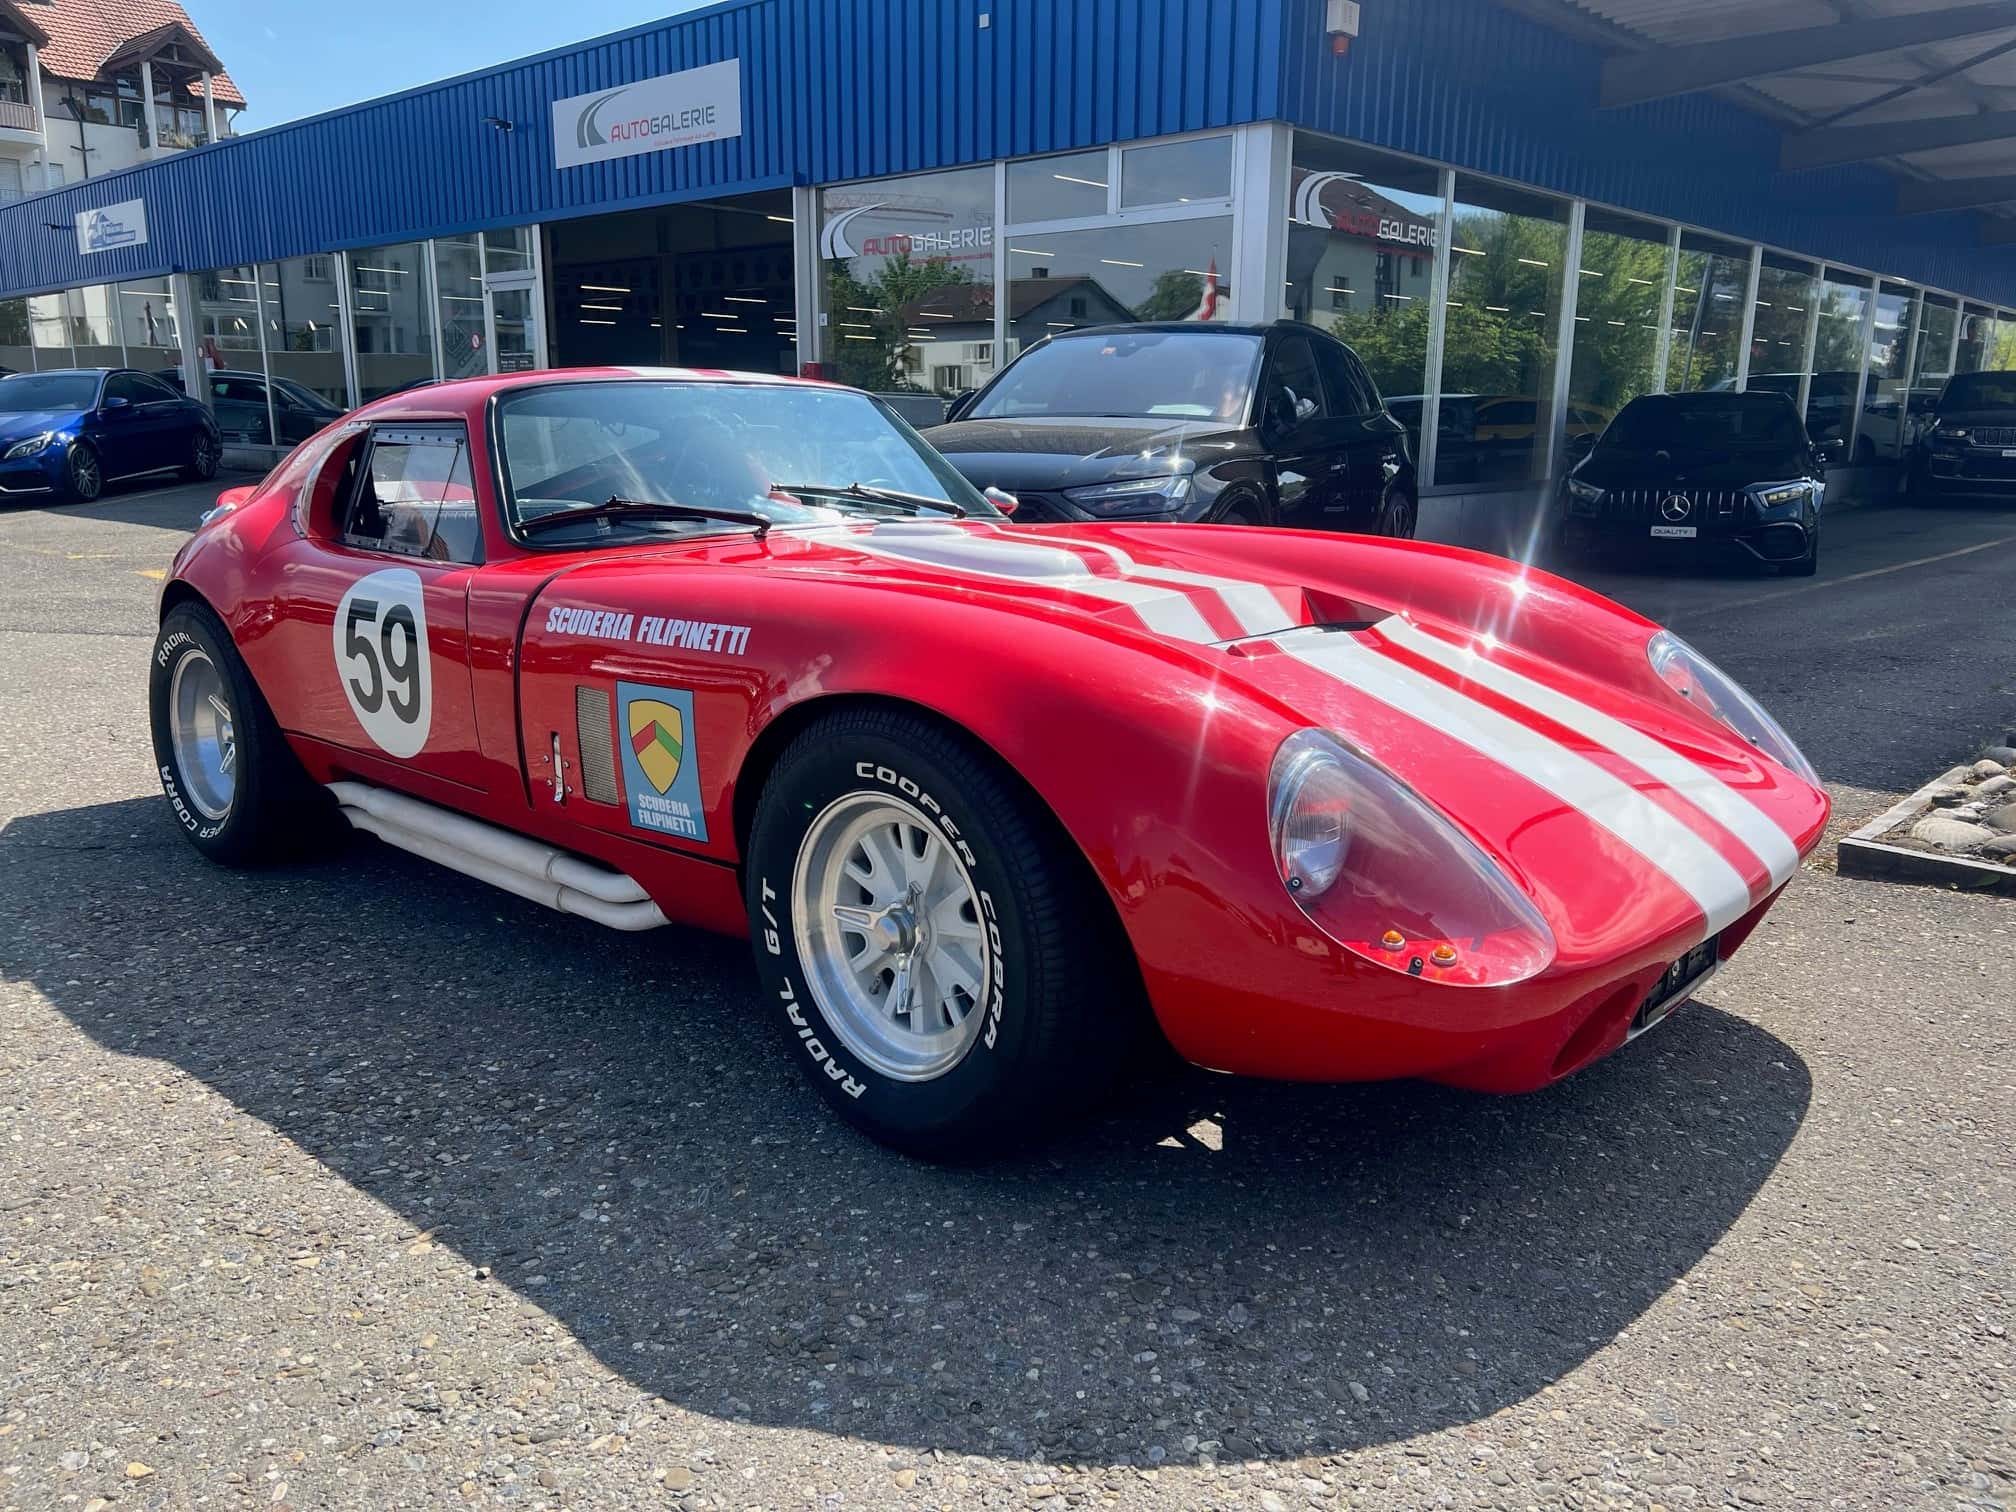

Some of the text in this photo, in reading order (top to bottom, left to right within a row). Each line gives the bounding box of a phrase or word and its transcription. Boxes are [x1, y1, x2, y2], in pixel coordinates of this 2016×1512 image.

[611, 106, 715, 144] AUTOGALERIE
[863, 226, 992, 256] AUTOGALERIE
[157, 632, 195, 667] RADIAL
[546, 606, 752, 656] SCUDERIA FILIPINETTI
[346, 598, 420, 723] 59
[160, 765, 198, 831] COBRA
[638, 793, 690, 818] SCUDERIA
[638, 808, 697, 835] FILIPINETTI
[856, 762, 1003, 1050] COOPER COBRA
[762, 877, 867, 1099] RADIAL G/T
